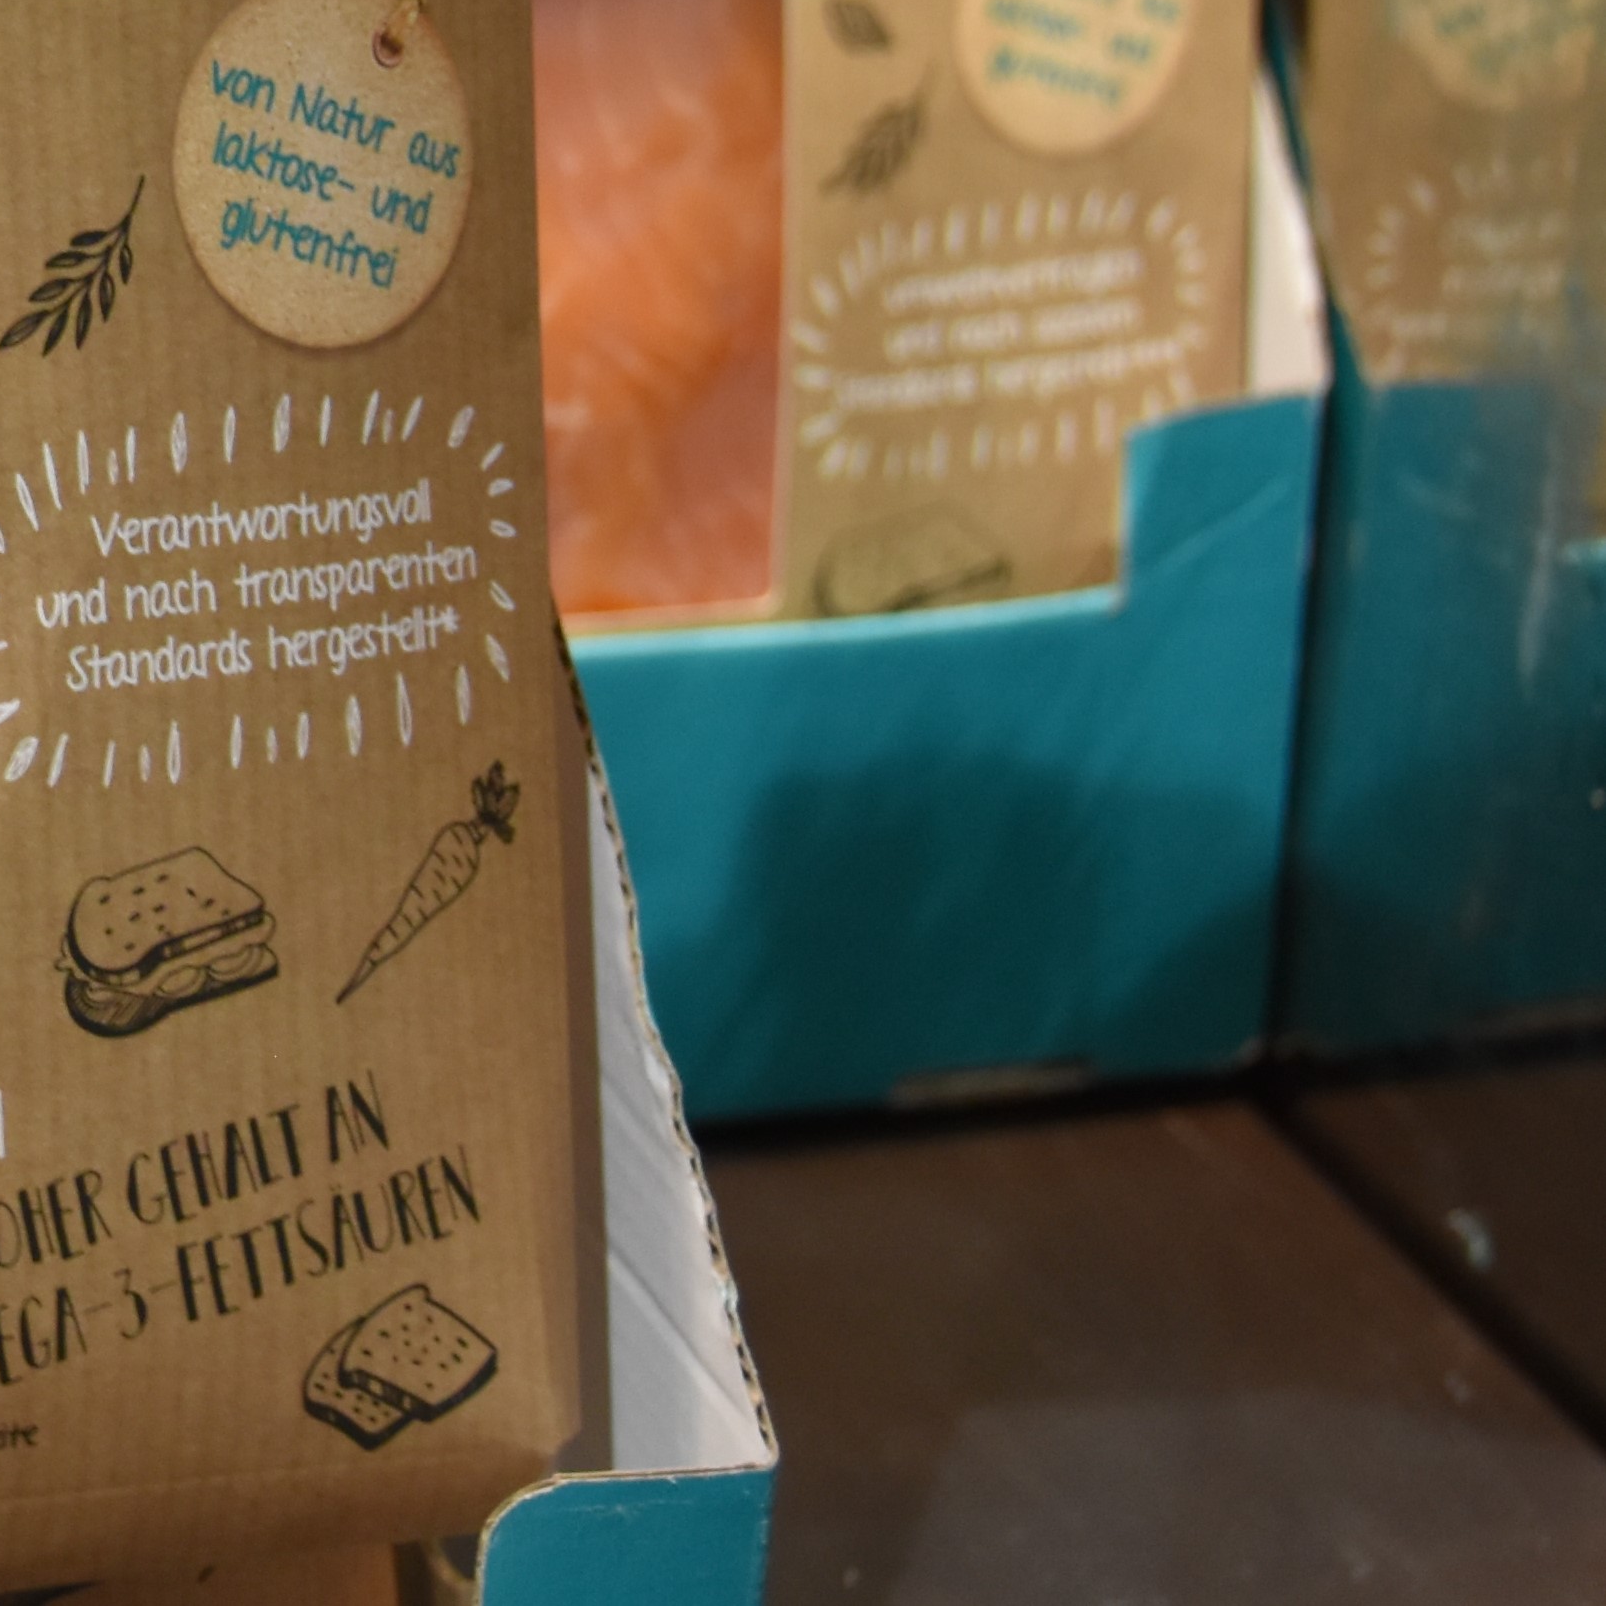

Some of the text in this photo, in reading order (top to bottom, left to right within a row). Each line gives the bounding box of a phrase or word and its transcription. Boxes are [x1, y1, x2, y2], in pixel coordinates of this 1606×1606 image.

[211, 60, 460, 178] von Natur aus
[212, 122, 433, 233] laktose- und
[220, 197, 399, 289] glutenfrei
[91, 477, 431, 558] Verantwortungsvoll
[36, 540, 478, 629] und nach transparenten
[127, 1102, 303, 1226] GEHALT
[325, 1069, 389, 1163] AN
